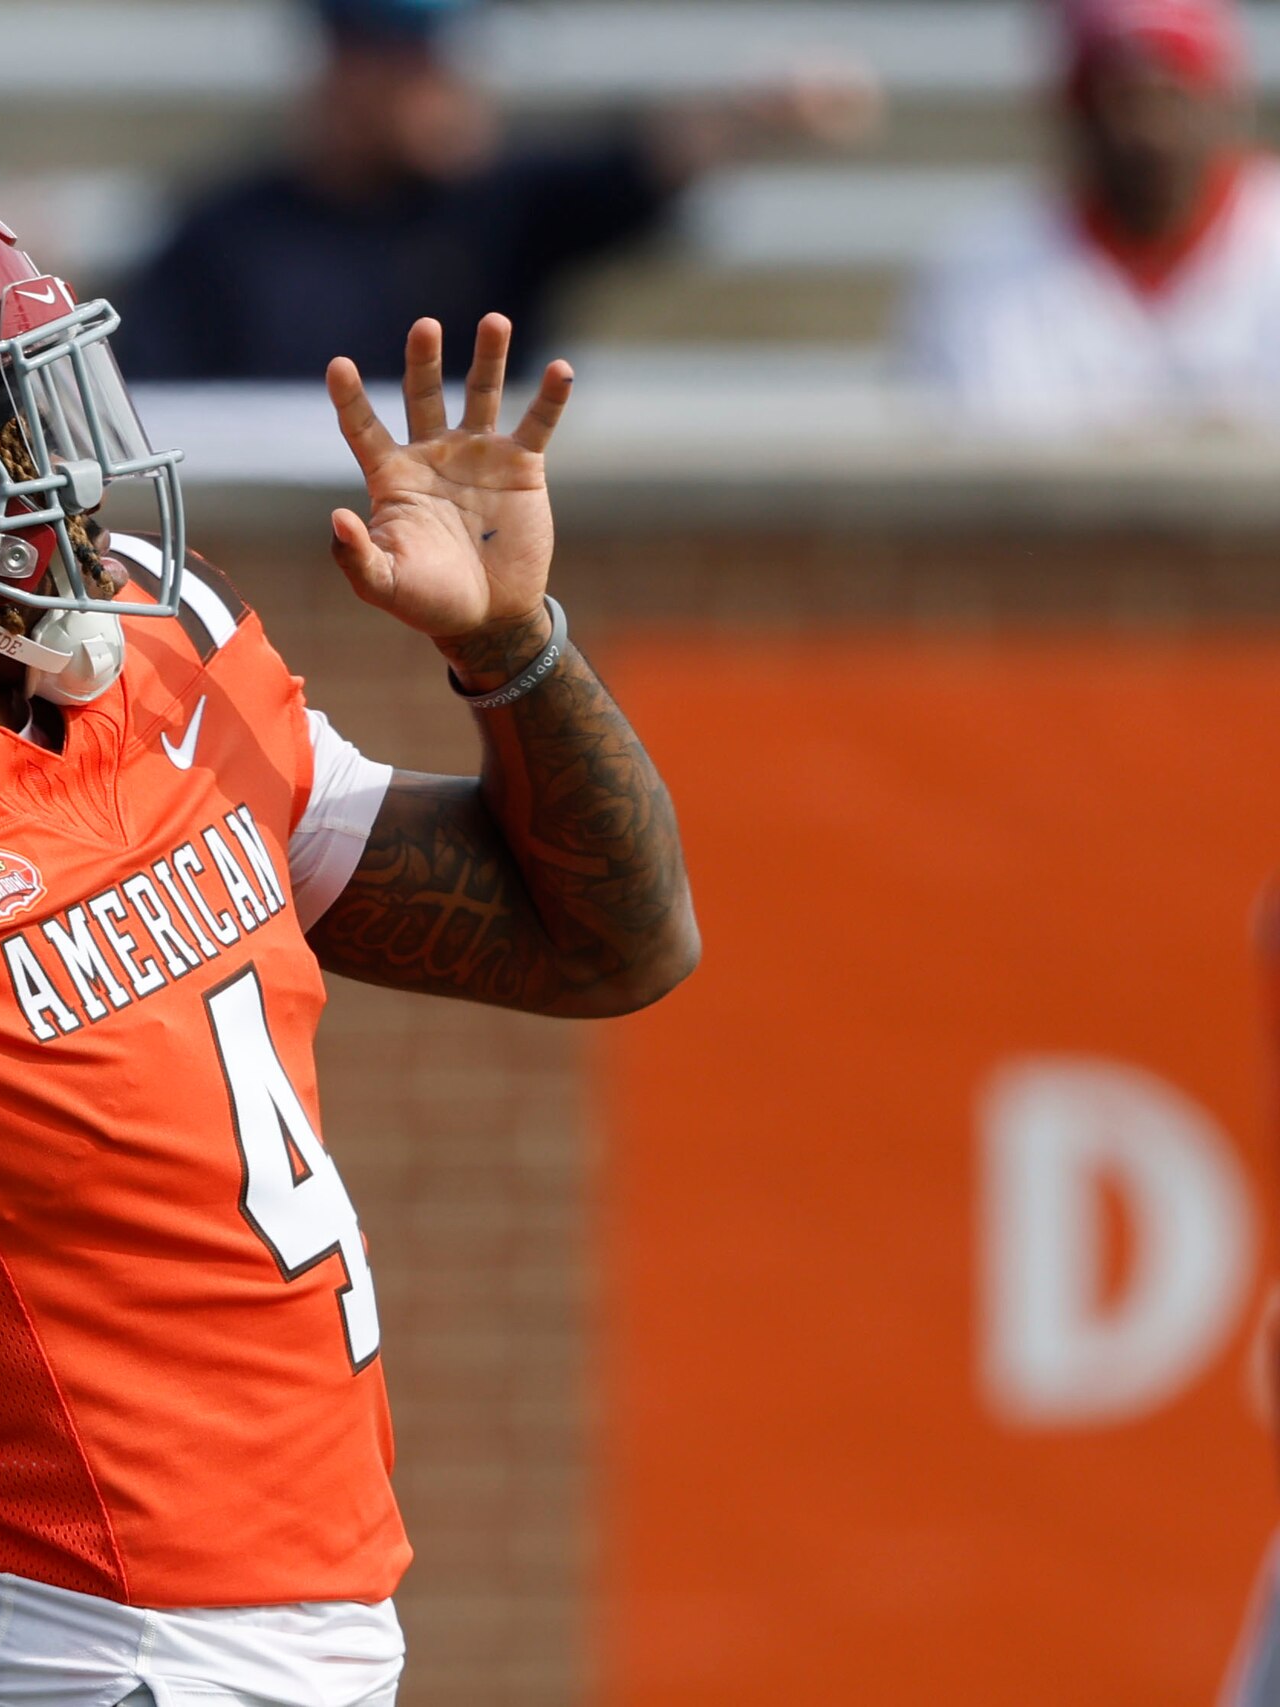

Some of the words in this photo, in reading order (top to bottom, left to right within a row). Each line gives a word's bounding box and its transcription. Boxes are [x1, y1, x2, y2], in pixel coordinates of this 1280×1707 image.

[519, 675, 537, 688] IS
[536, 645, 559, 674] GOD
[0, 802, 287, 1045] AMERICAN
[202, 962, 381, 1376] 4
[975, 1052, 1280, 1433] D
